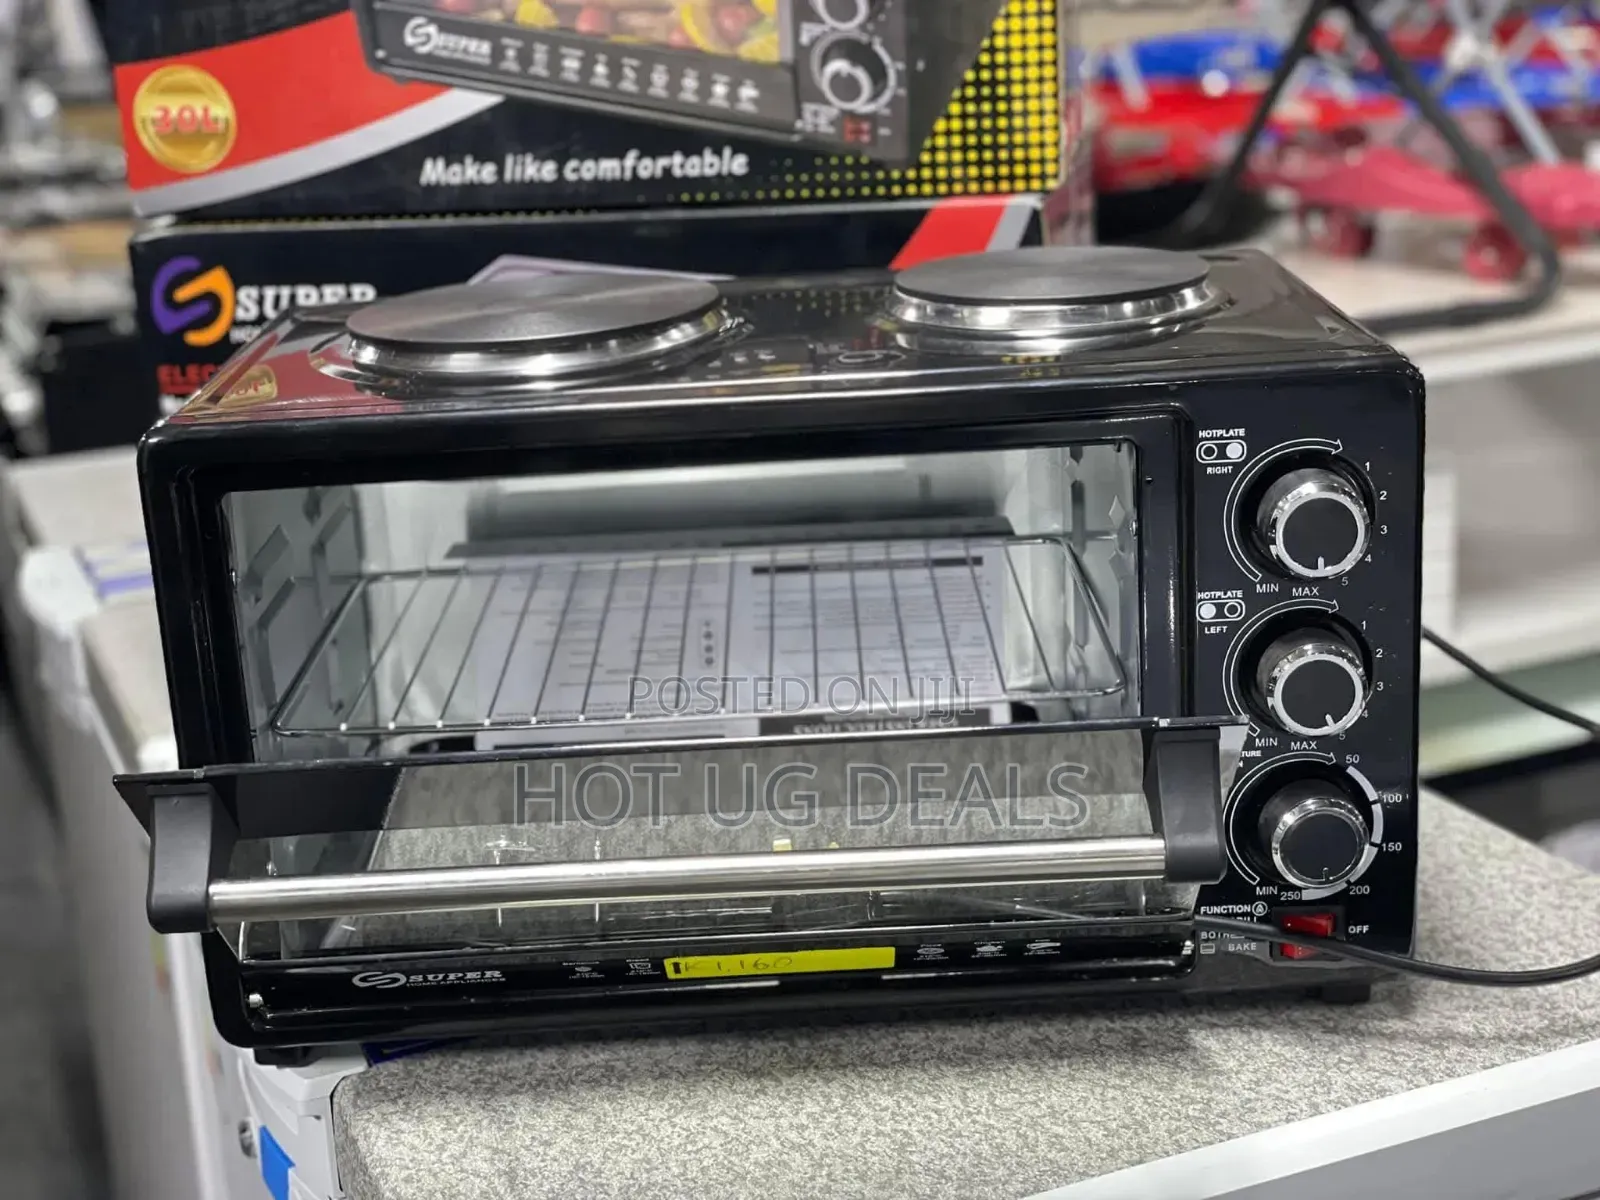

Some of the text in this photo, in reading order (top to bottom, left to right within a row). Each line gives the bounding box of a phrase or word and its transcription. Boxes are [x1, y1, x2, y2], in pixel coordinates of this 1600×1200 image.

[152, 104, 224, 134] 30L
[419, 145, 749, 186] Make like comfortable
[1199, 428, 1246, 438] HOTPLATE
[1206, 466, 1234, 475] RIGHT
[1365, 462, 1371, 471] 1
[1379, 491, 1388, 500] 2
[1380, 525, 1388, 535] 3
[1364, 553, 1372, 563] 4
[1341, 577, 1349, 586] 5
[1198, 590, 1243, 599] HOTPLATE
[1256, 583, 1319, 597] MIN MAX
[1361, 621, 1367, 630] 1
[1205, 626, 1228, 635] LEFT
[1375, 649, 1383, 658] 2
[1376, 682, 1384, 691] 3
[1362, 710, 1369, 719] 4
[1339, 732, 1346, 741] 5
[1255, 737, 1317, 751] MIN MAX
[1346, 755, 1360, 764] 50
[1382, 793, 1402, 803] 100
[1381, 842, 1402, 851] 150
[1256, 886, 1278, 896] MIN
[1349, 885, 1370, 895] 200
[1280, 891, 1300, 901] 250
[1200, 904, 1251, 915] FUNCTION
[1348, 925, 1369, 934] OFF
[1228, 943, 1257, 952] BAKE
[408, 970, 503, 984] SUPER
